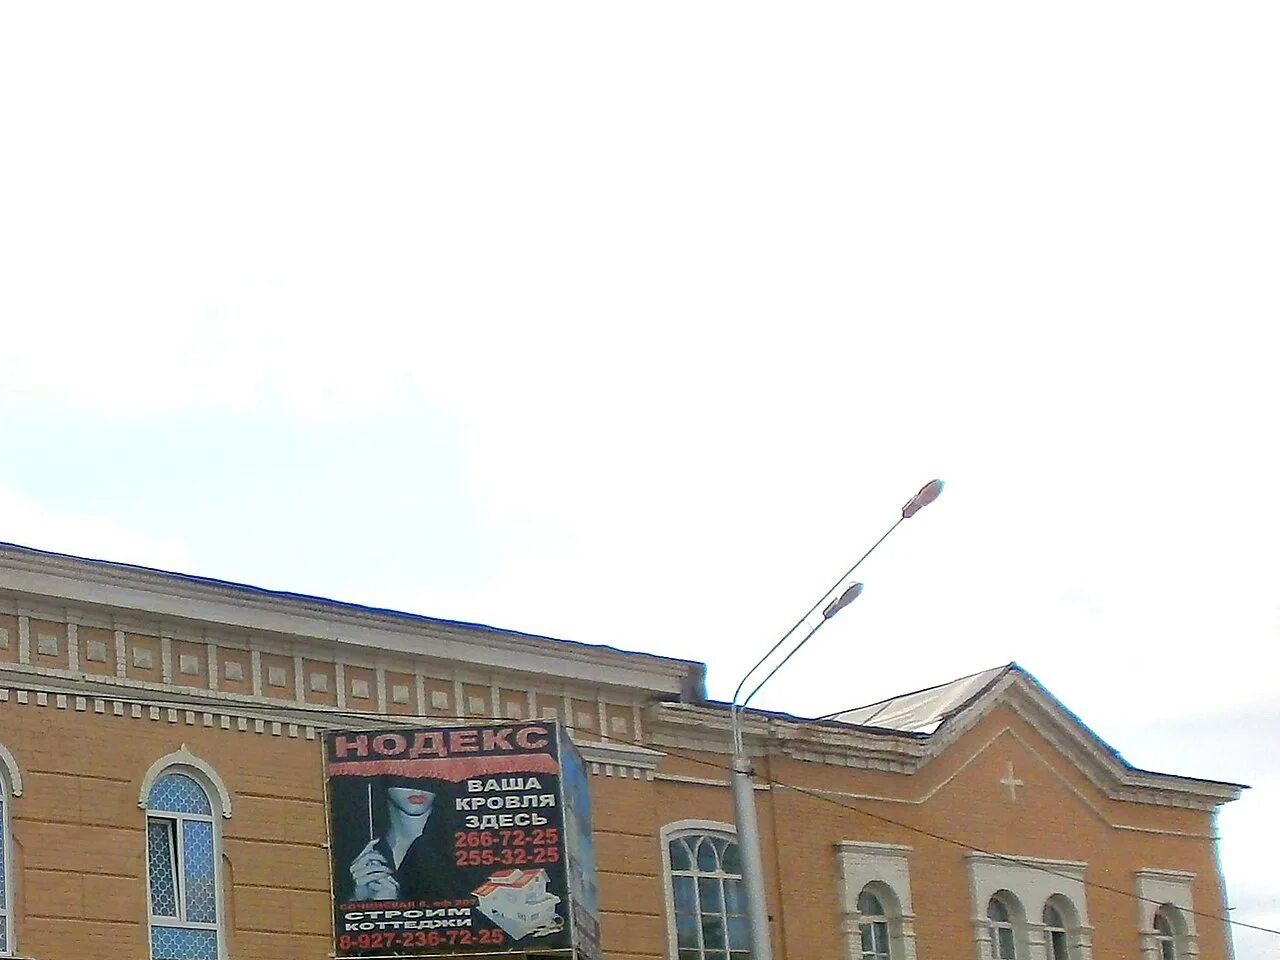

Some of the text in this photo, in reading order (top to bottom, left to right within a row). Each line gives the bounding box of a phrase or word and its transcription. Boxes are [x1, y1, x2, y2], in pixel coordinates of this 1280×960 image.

[335, 727, 549, 760] НОДЕКС
[467, 777, 542, 793] ВАША
[455, 794, 556, 811] КРОВЛЯ
[465, 813, 548, 830] ЗДЕСЬ
[454, 829, 559, 848] 266-72-25
[455, 848, 560, 866] 255-32-25
[344, 907, 471, 921] СТРОИМ
[345, 919, 472, 931] КОТТЕДЖИ
[339, 928, 504, 950] 8-927-236-72-25
